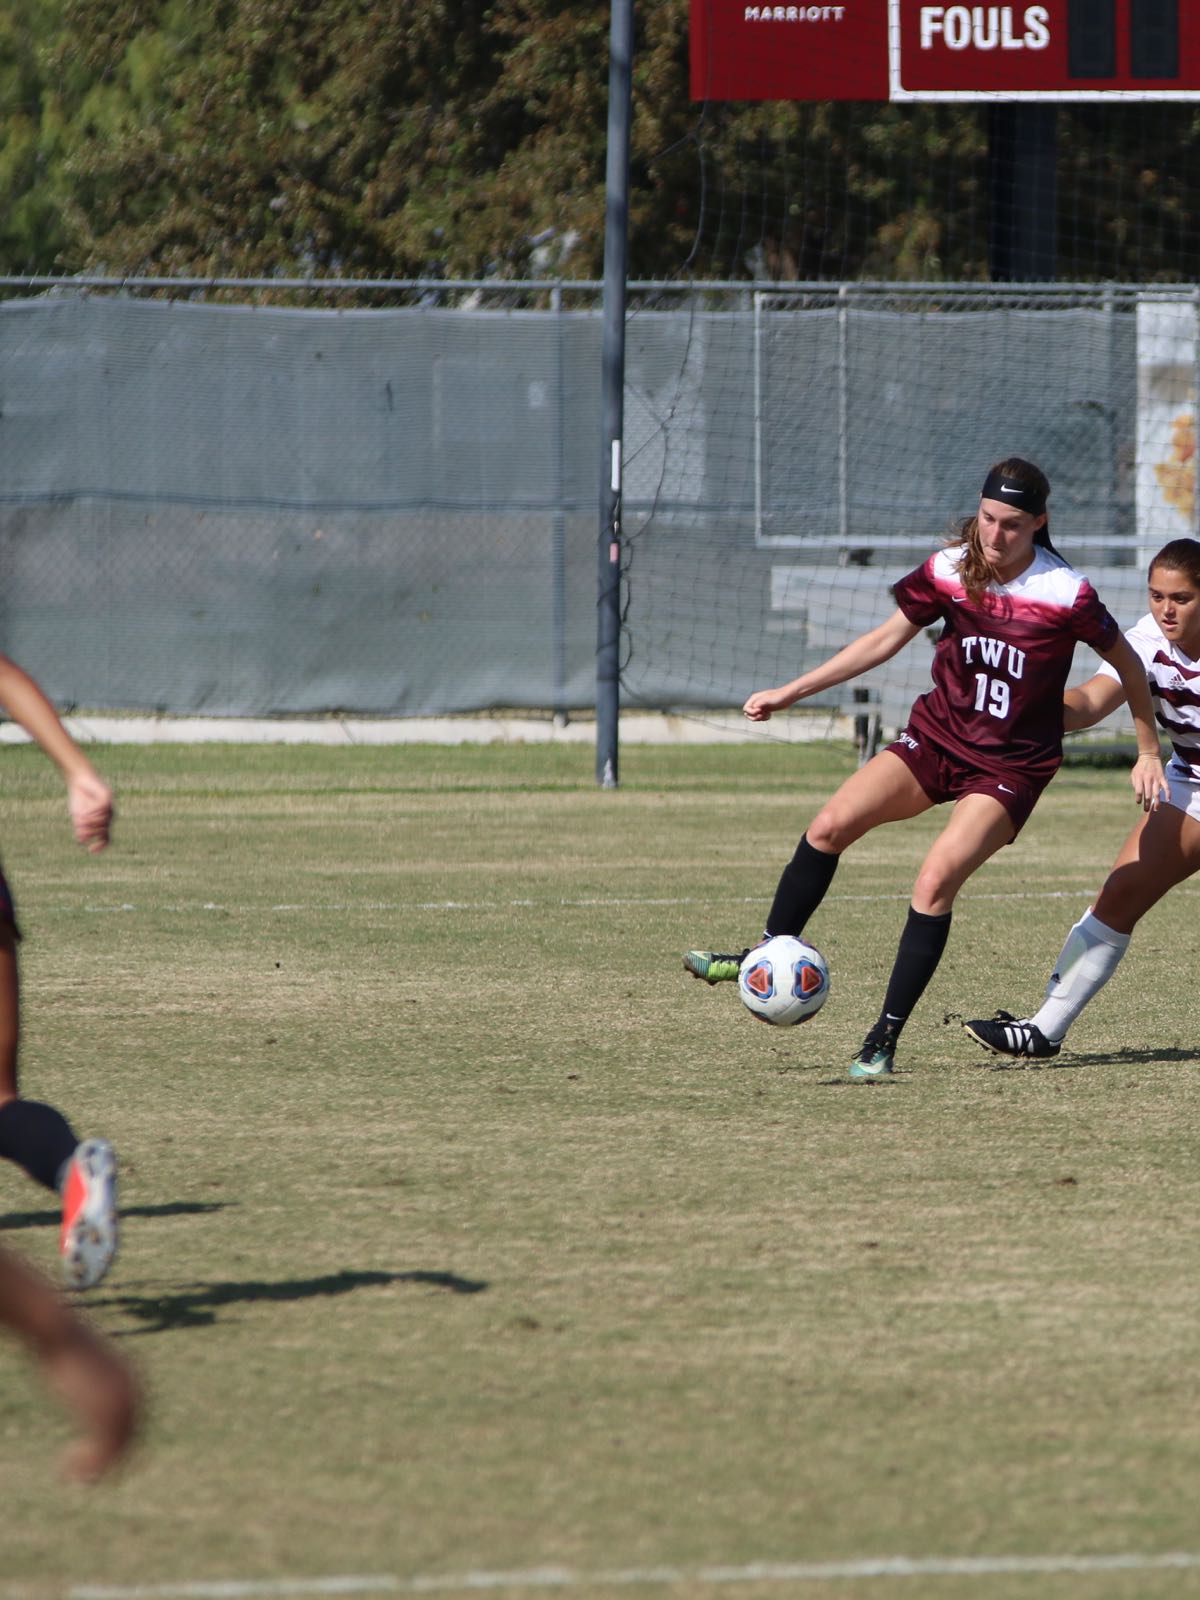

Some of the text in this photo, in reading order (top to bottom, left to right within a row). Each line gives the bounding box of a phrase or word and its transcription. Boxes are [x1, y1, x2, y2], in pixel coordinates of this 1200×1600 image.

[744, 6, 845, 22] MARRIOTT
[919, 6, 1051, 49] FOULS
[961, 636, 1026, 680] TWU
[974, 673, 1011, 719] 19
